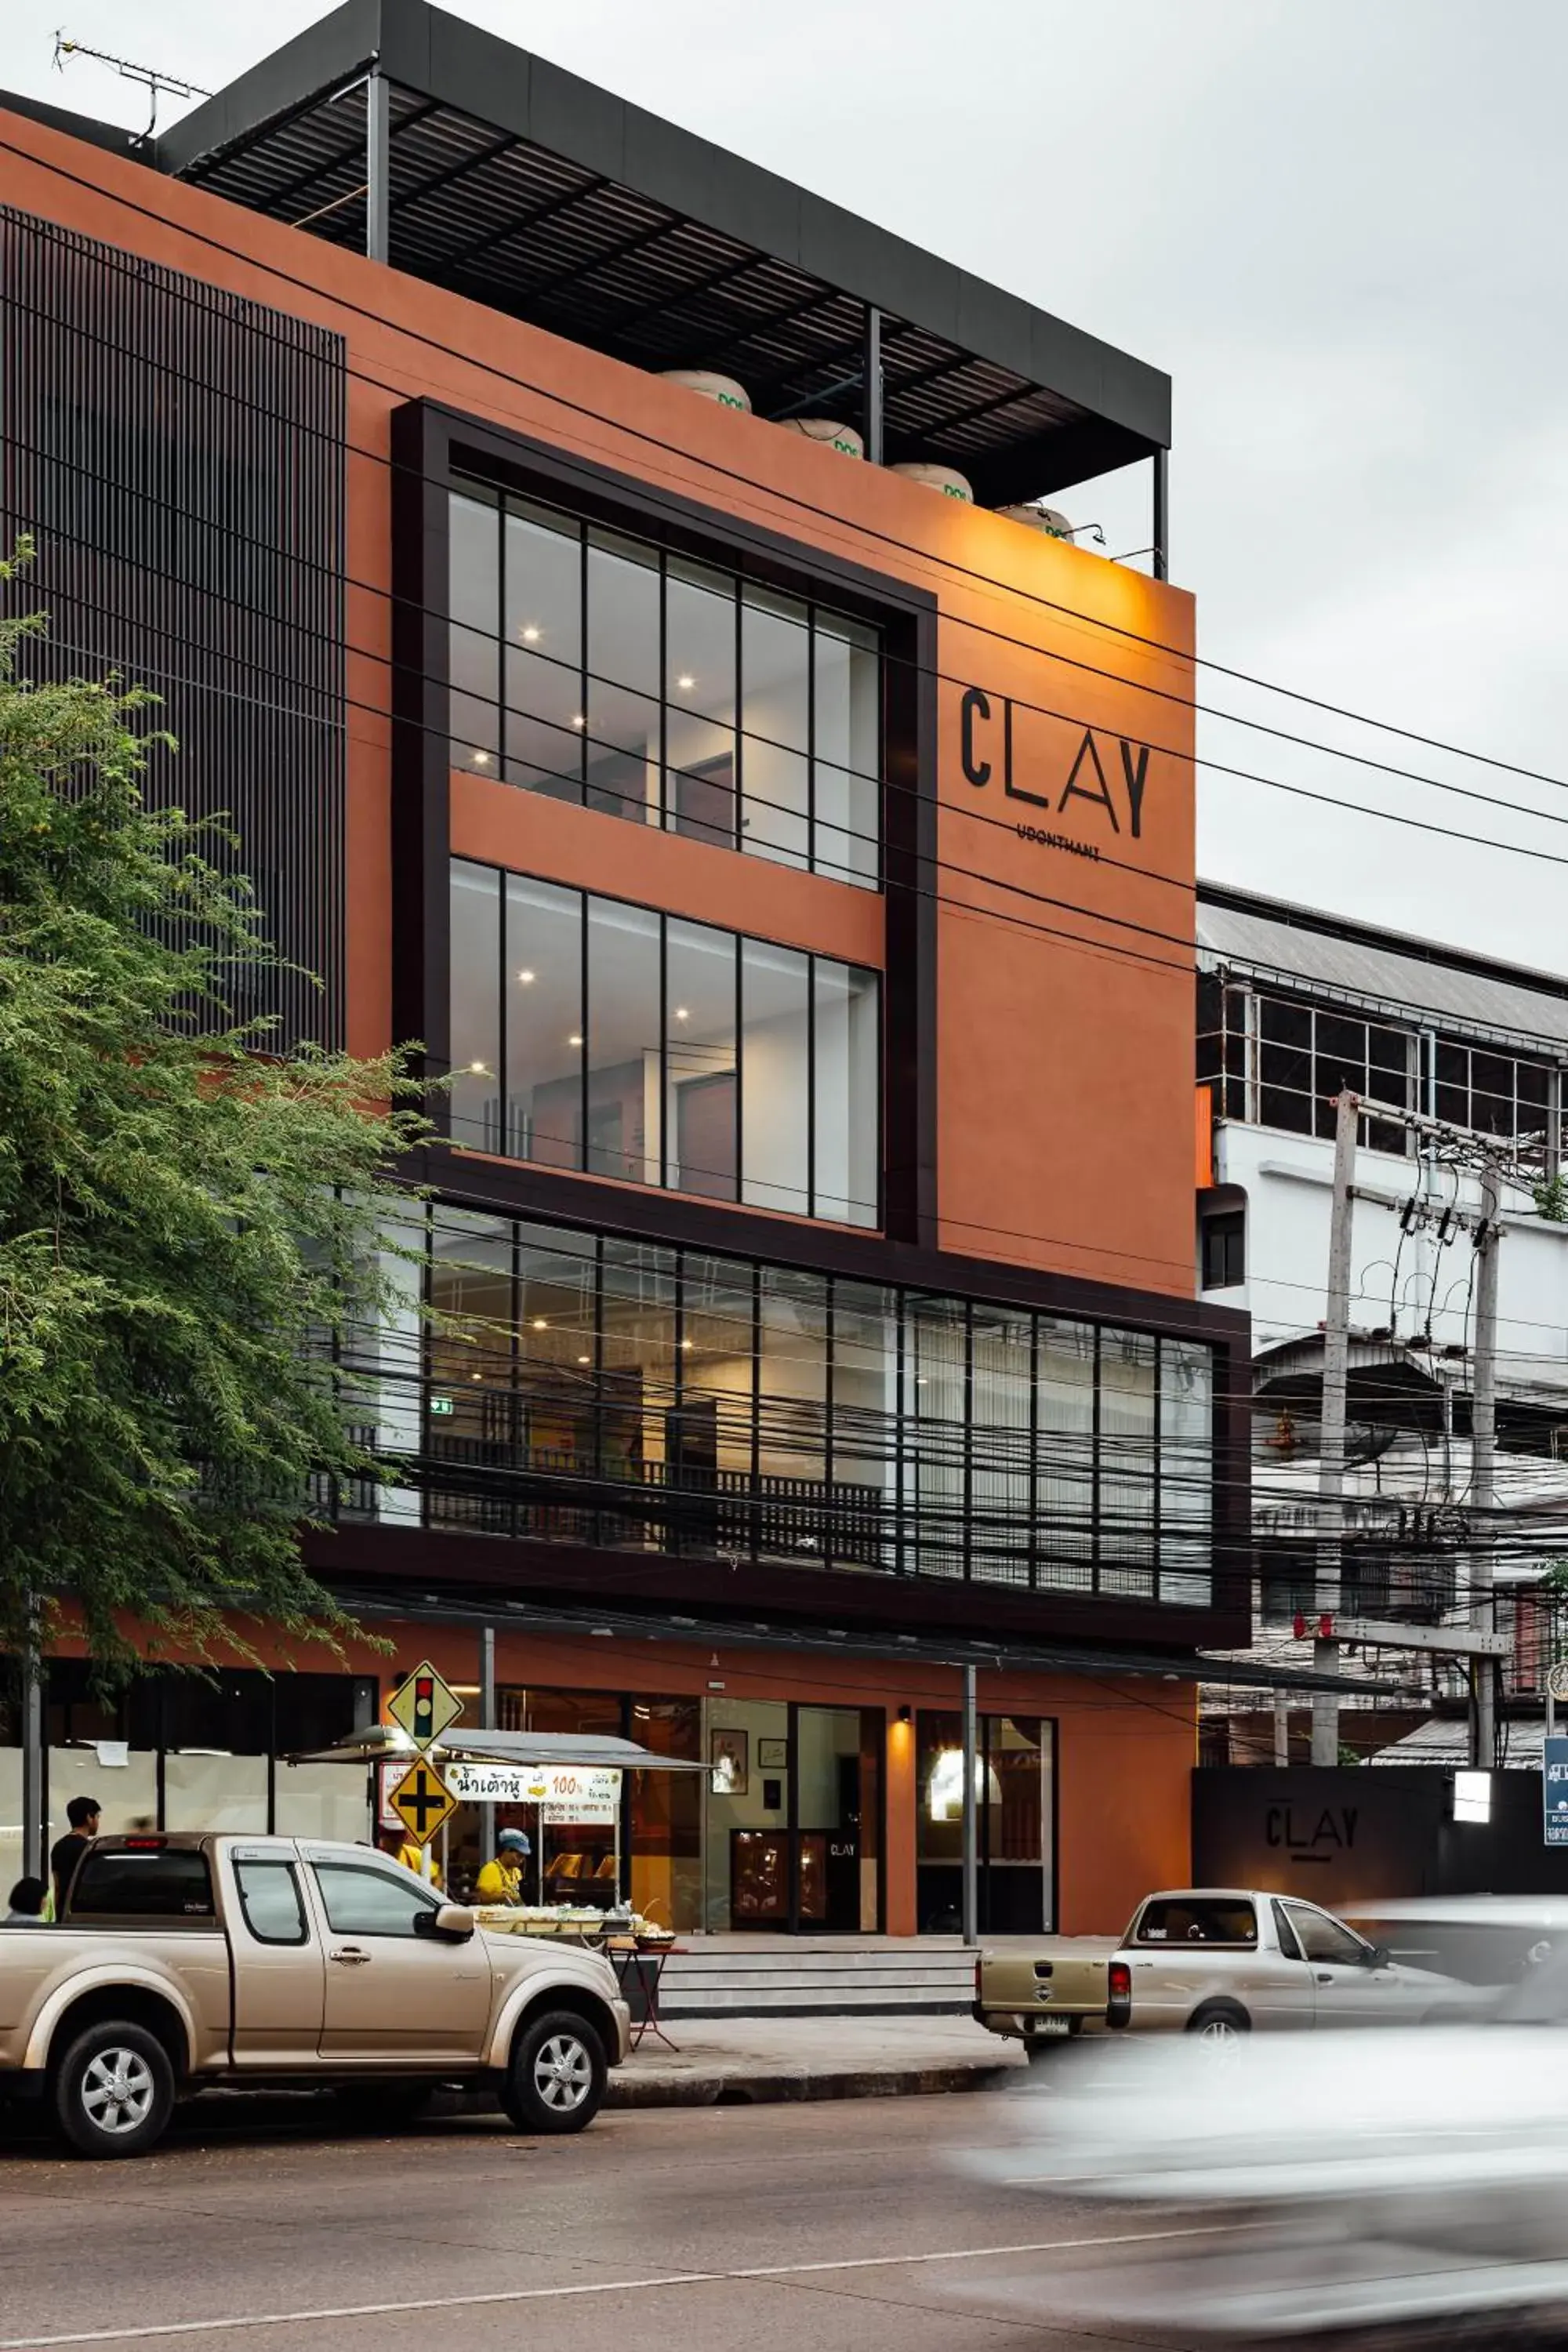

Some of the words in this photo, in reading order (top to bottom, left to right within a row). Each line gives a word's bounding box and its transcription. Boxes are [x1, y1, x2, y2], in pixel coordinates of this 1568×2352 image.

[961, 688, 1149, 839] CLAY
[1017, 823, 1099, 862] UDONTHANI
[1265, 1806, 1359, 1849] CLAY
